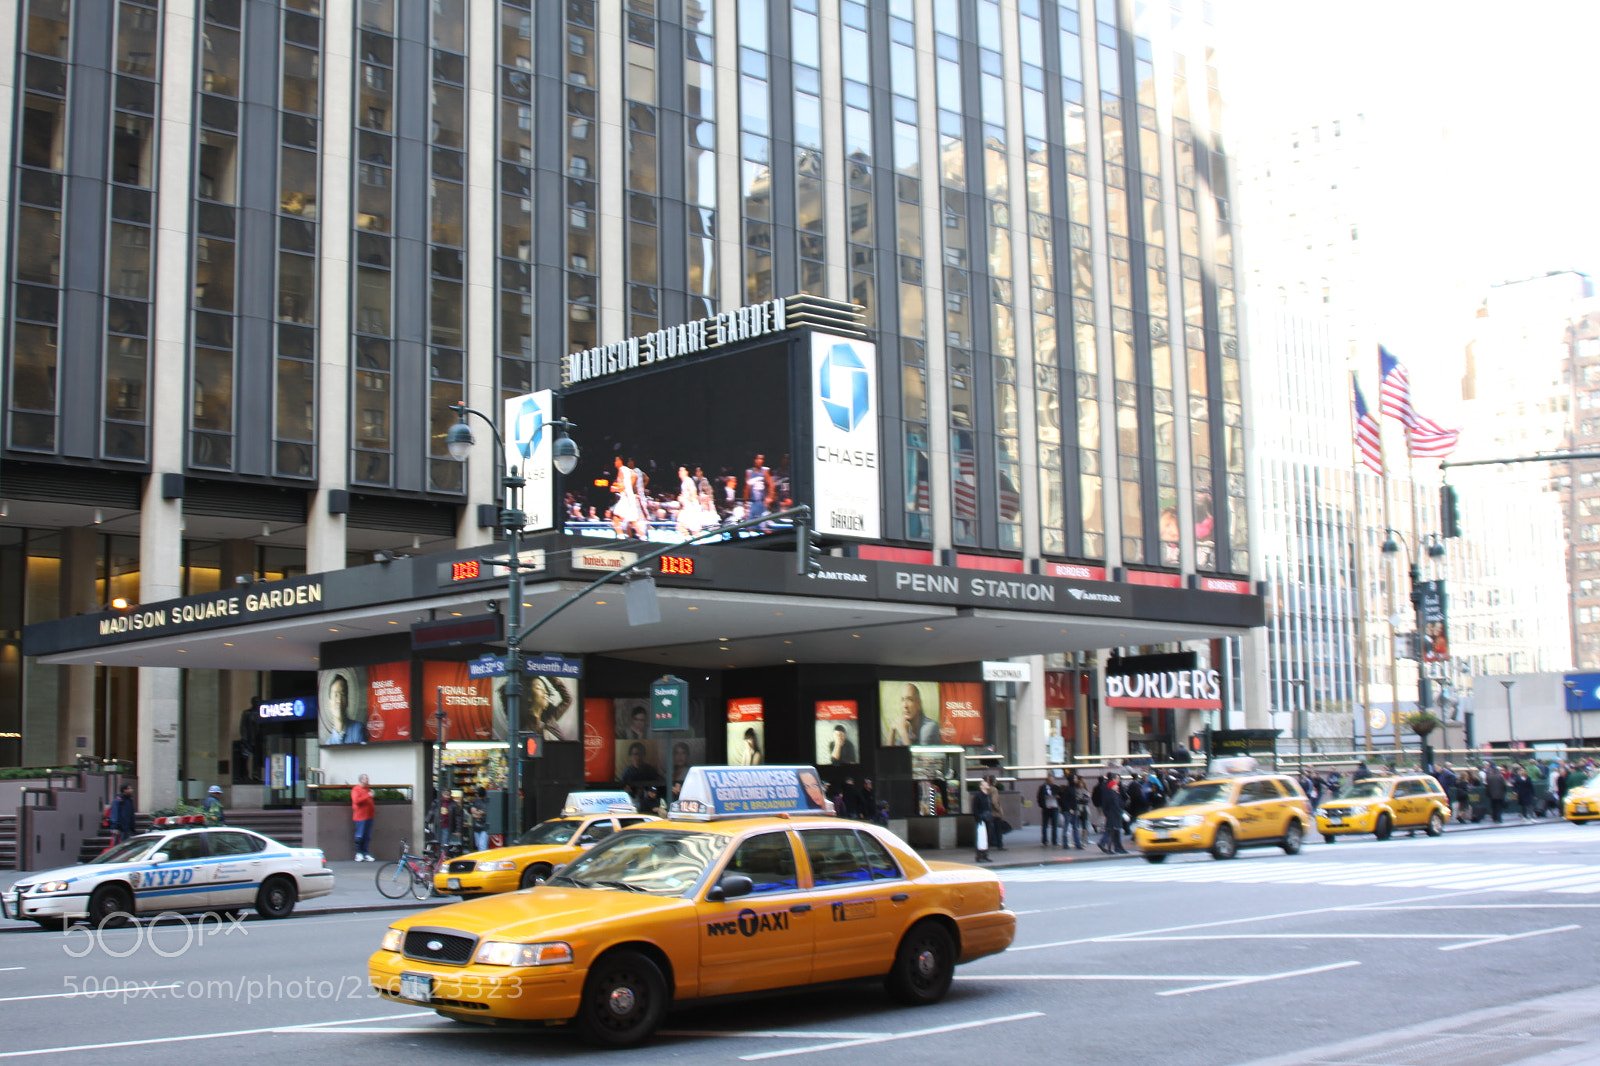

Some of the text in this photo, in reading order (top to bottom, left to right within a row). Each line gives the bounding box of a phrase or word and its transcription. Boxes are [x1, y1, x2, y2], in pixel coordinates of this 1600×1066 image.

[570, 297, 785, 383] MADISON SQUARE GARDEN
[815, 445, 877, 468] CHASE
[817, 570, 868, 583] AMTRAK
[1055, 565, 1091, 578] BORDERS
[896, 571, 1055, 602] PENN STATION
[1206, 580, 1238, 592] BORDERS
[1083, 593, 1121, 603] AMTRAK
[99, 583, 322, 635] MADISON SQUARE GARDEN
[526, 660, 579, 674] Seventh Ave
[468, 686, 477, 696] IS
[655, 687, 678, 697] Subway
[1106, 669, 1221, 701] BORDERS
[259, 702, 294, 718] CHASE
[706, 770, 799, 788] FLASHDANCERS
[716, 786, 799, 801] GENTLEMEN'S CLUB
[742, 801, 750, 811] &
[750, 800, 797, 810] BROADWAY
[141, 868, 193, 887] NYPD
[707, 908, 789, 938] NYC TAXI
